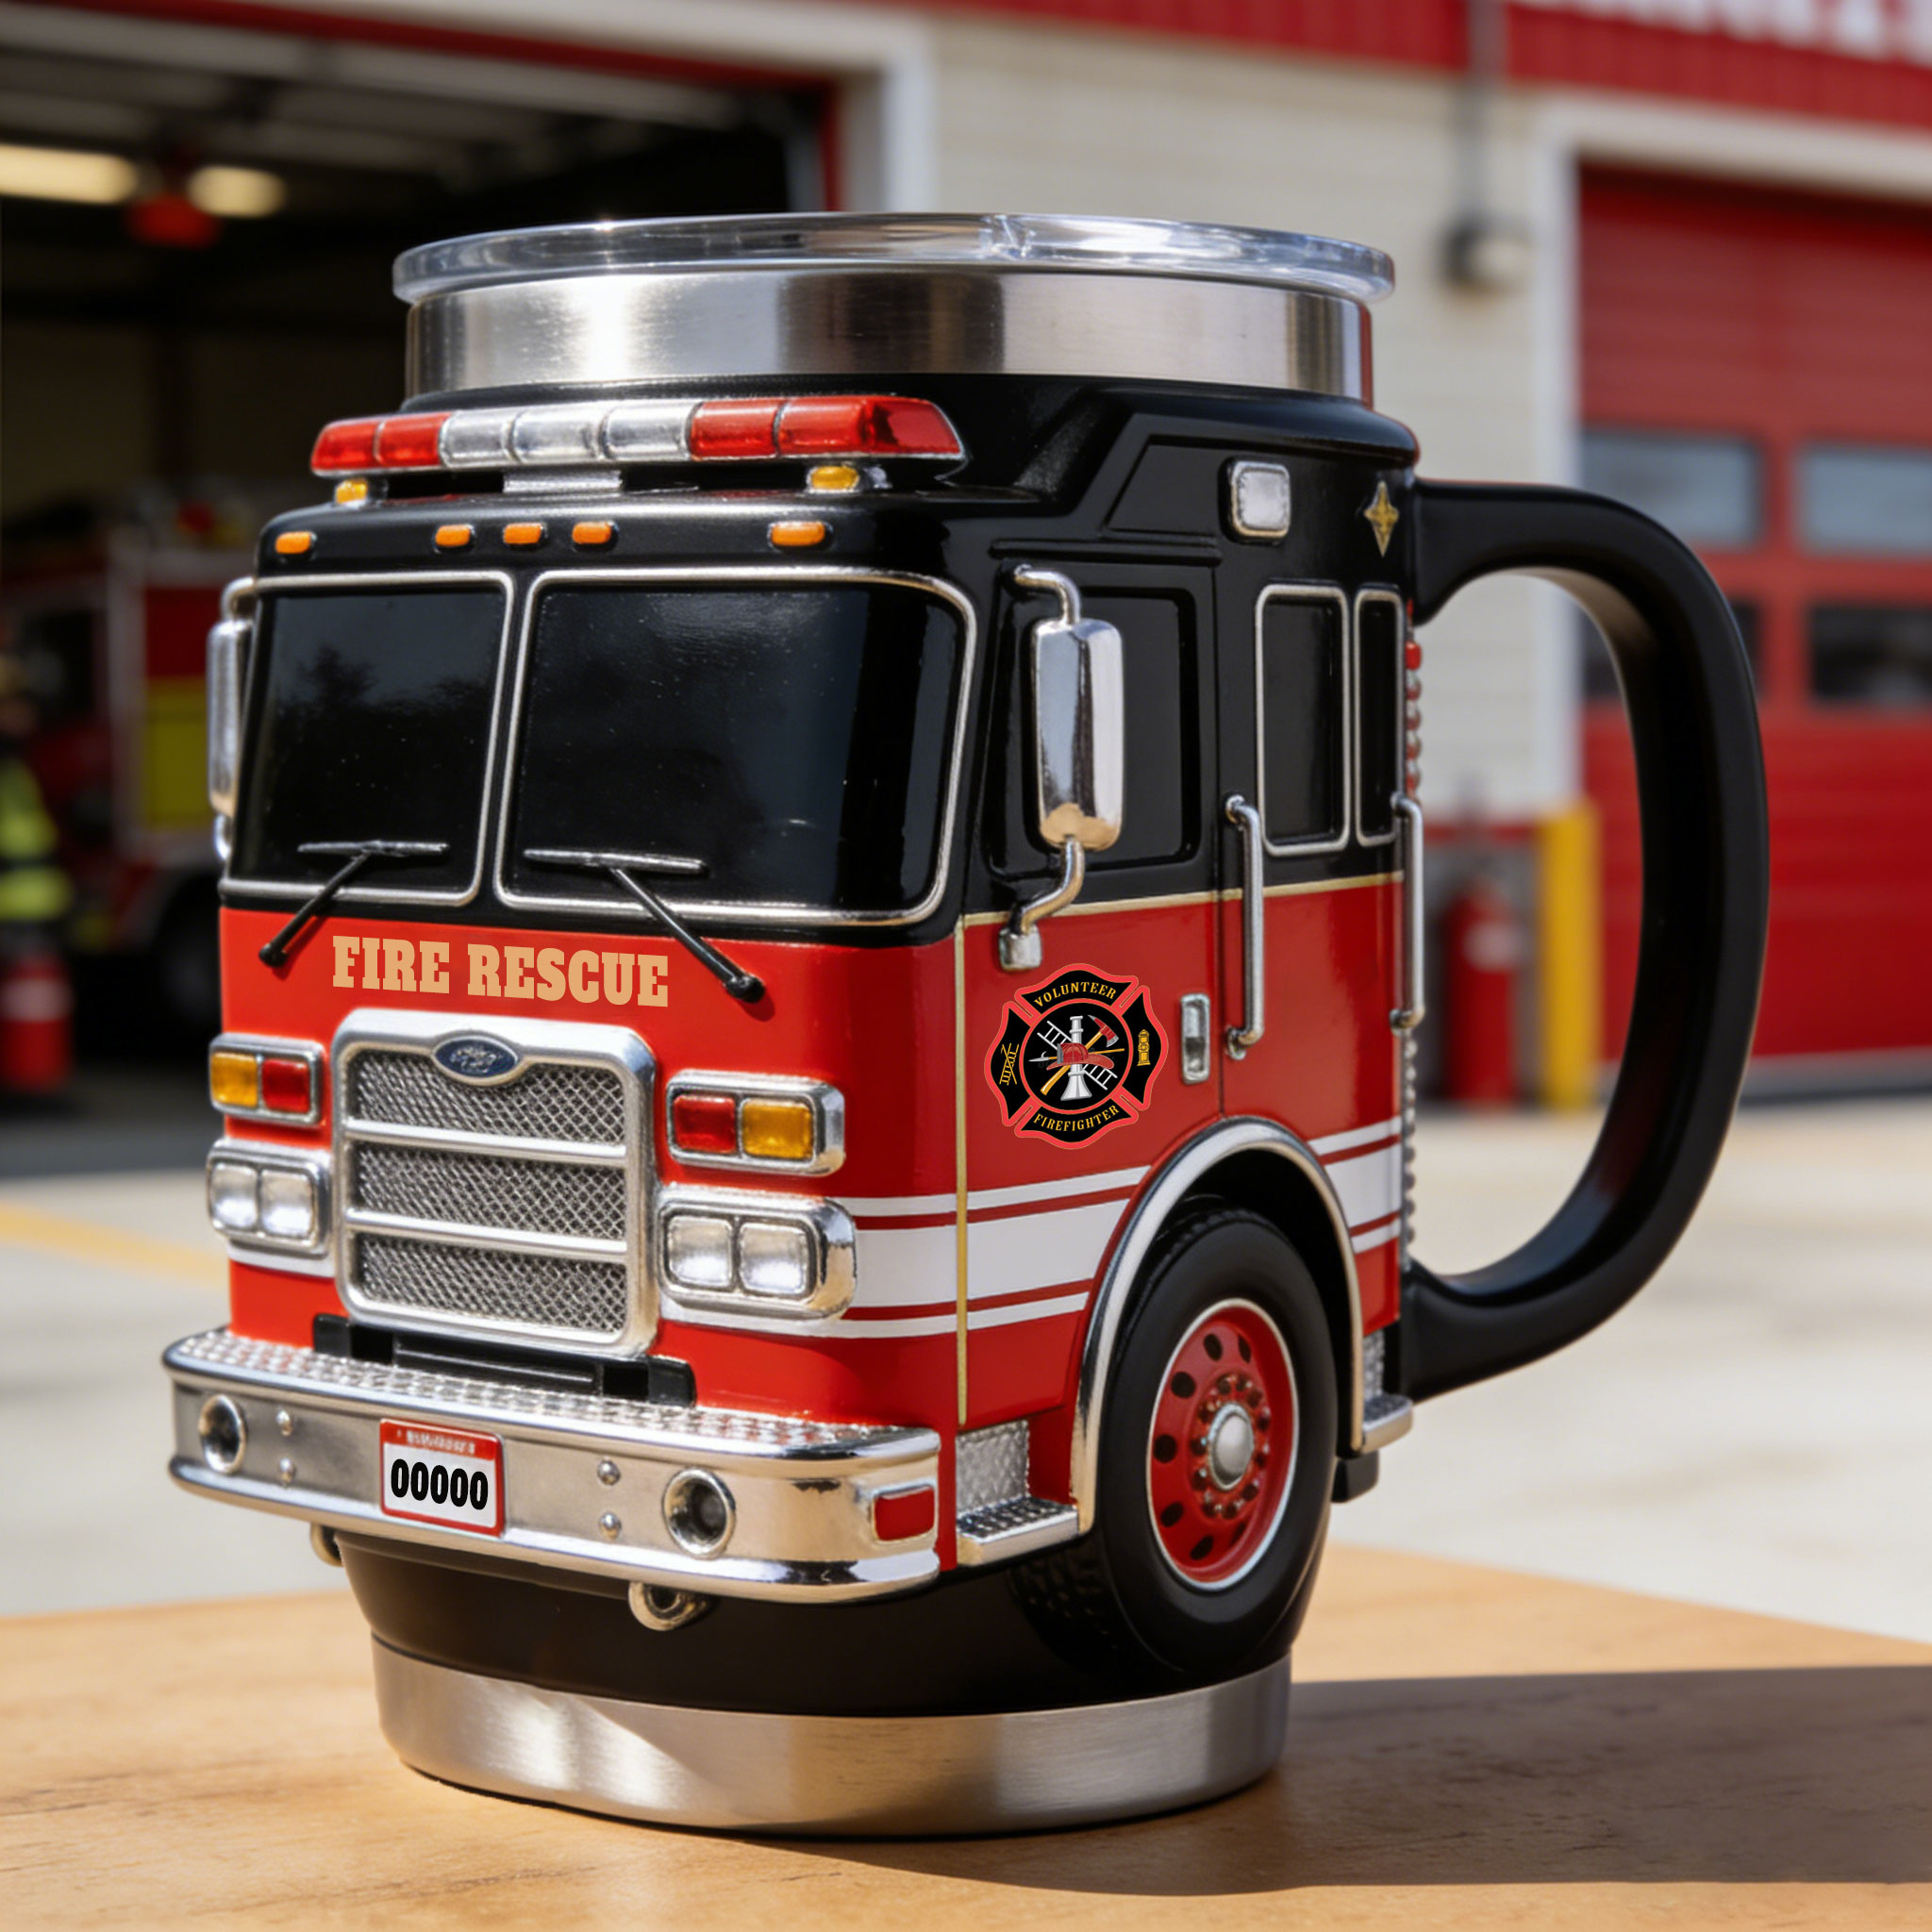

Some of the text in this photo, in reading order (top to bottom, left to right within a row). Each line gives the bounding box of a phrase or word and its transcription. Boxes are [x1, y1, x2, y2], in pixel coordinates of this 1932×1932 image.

[333, 935, 669, 1008] FIRE RESCUE
[1034, 982, 1117, 1008] VOLUNTEER
[1033, 1105, 1120, 1132] FIREFIGHTER
[391, 1458, 489, 1510] 00000
